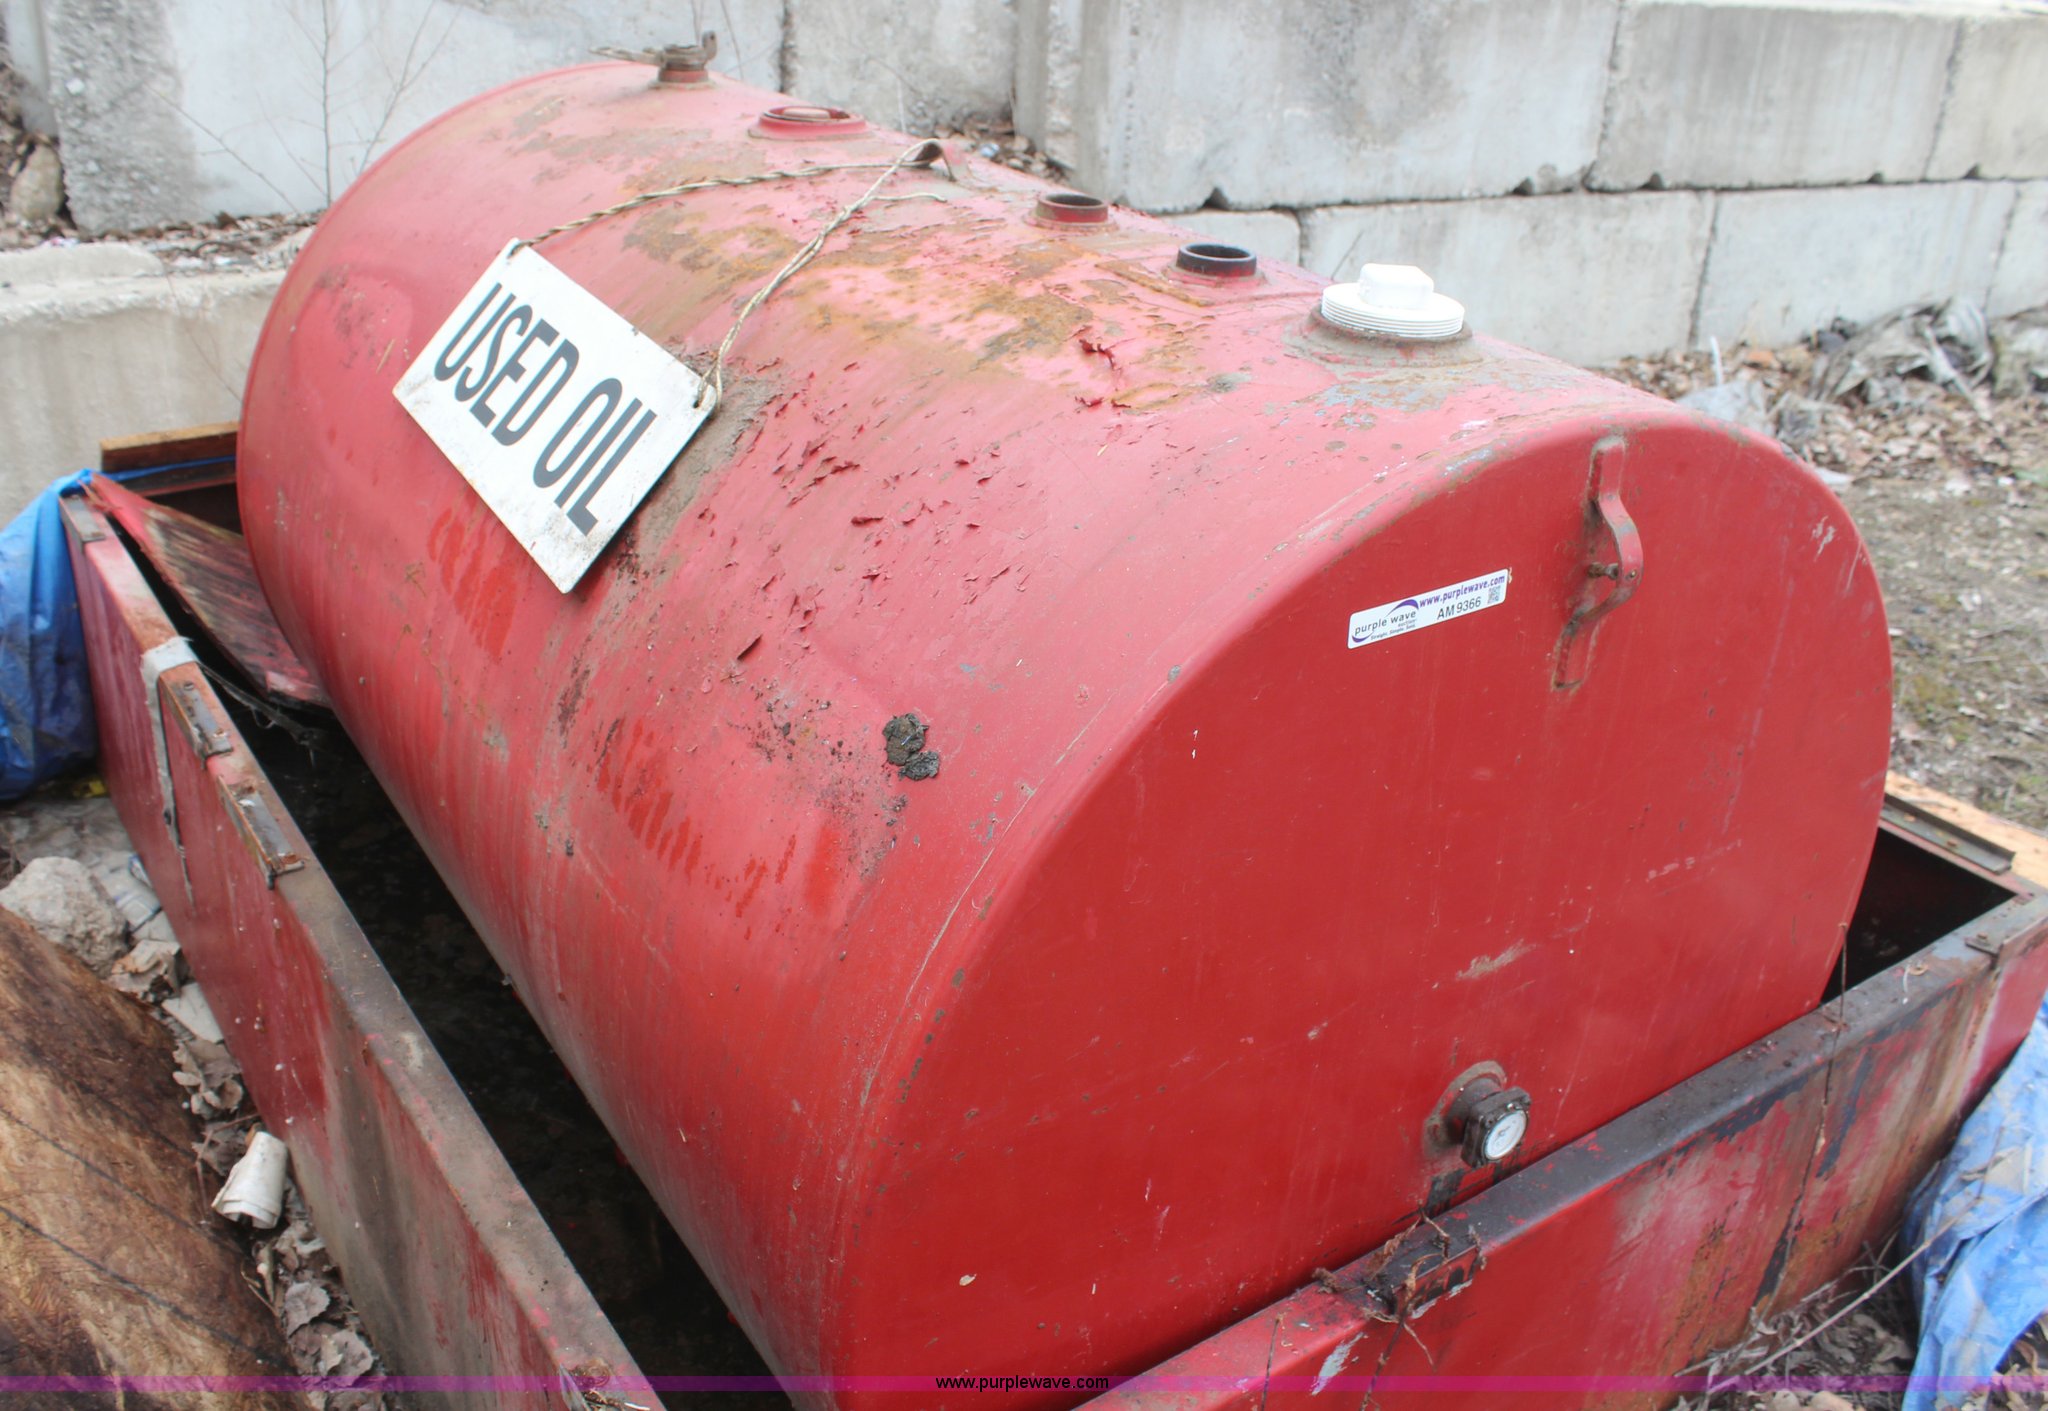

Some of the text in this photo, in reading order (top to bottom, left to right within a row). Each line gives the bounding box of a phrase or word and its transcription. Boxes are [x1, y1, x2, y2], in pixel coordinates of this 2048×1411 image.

[434, 282, 657, 537] USED OIL
[1419, 575, 1505, 608] www.purplewave.com
[1355, 611, 1416, 636] purple wave
